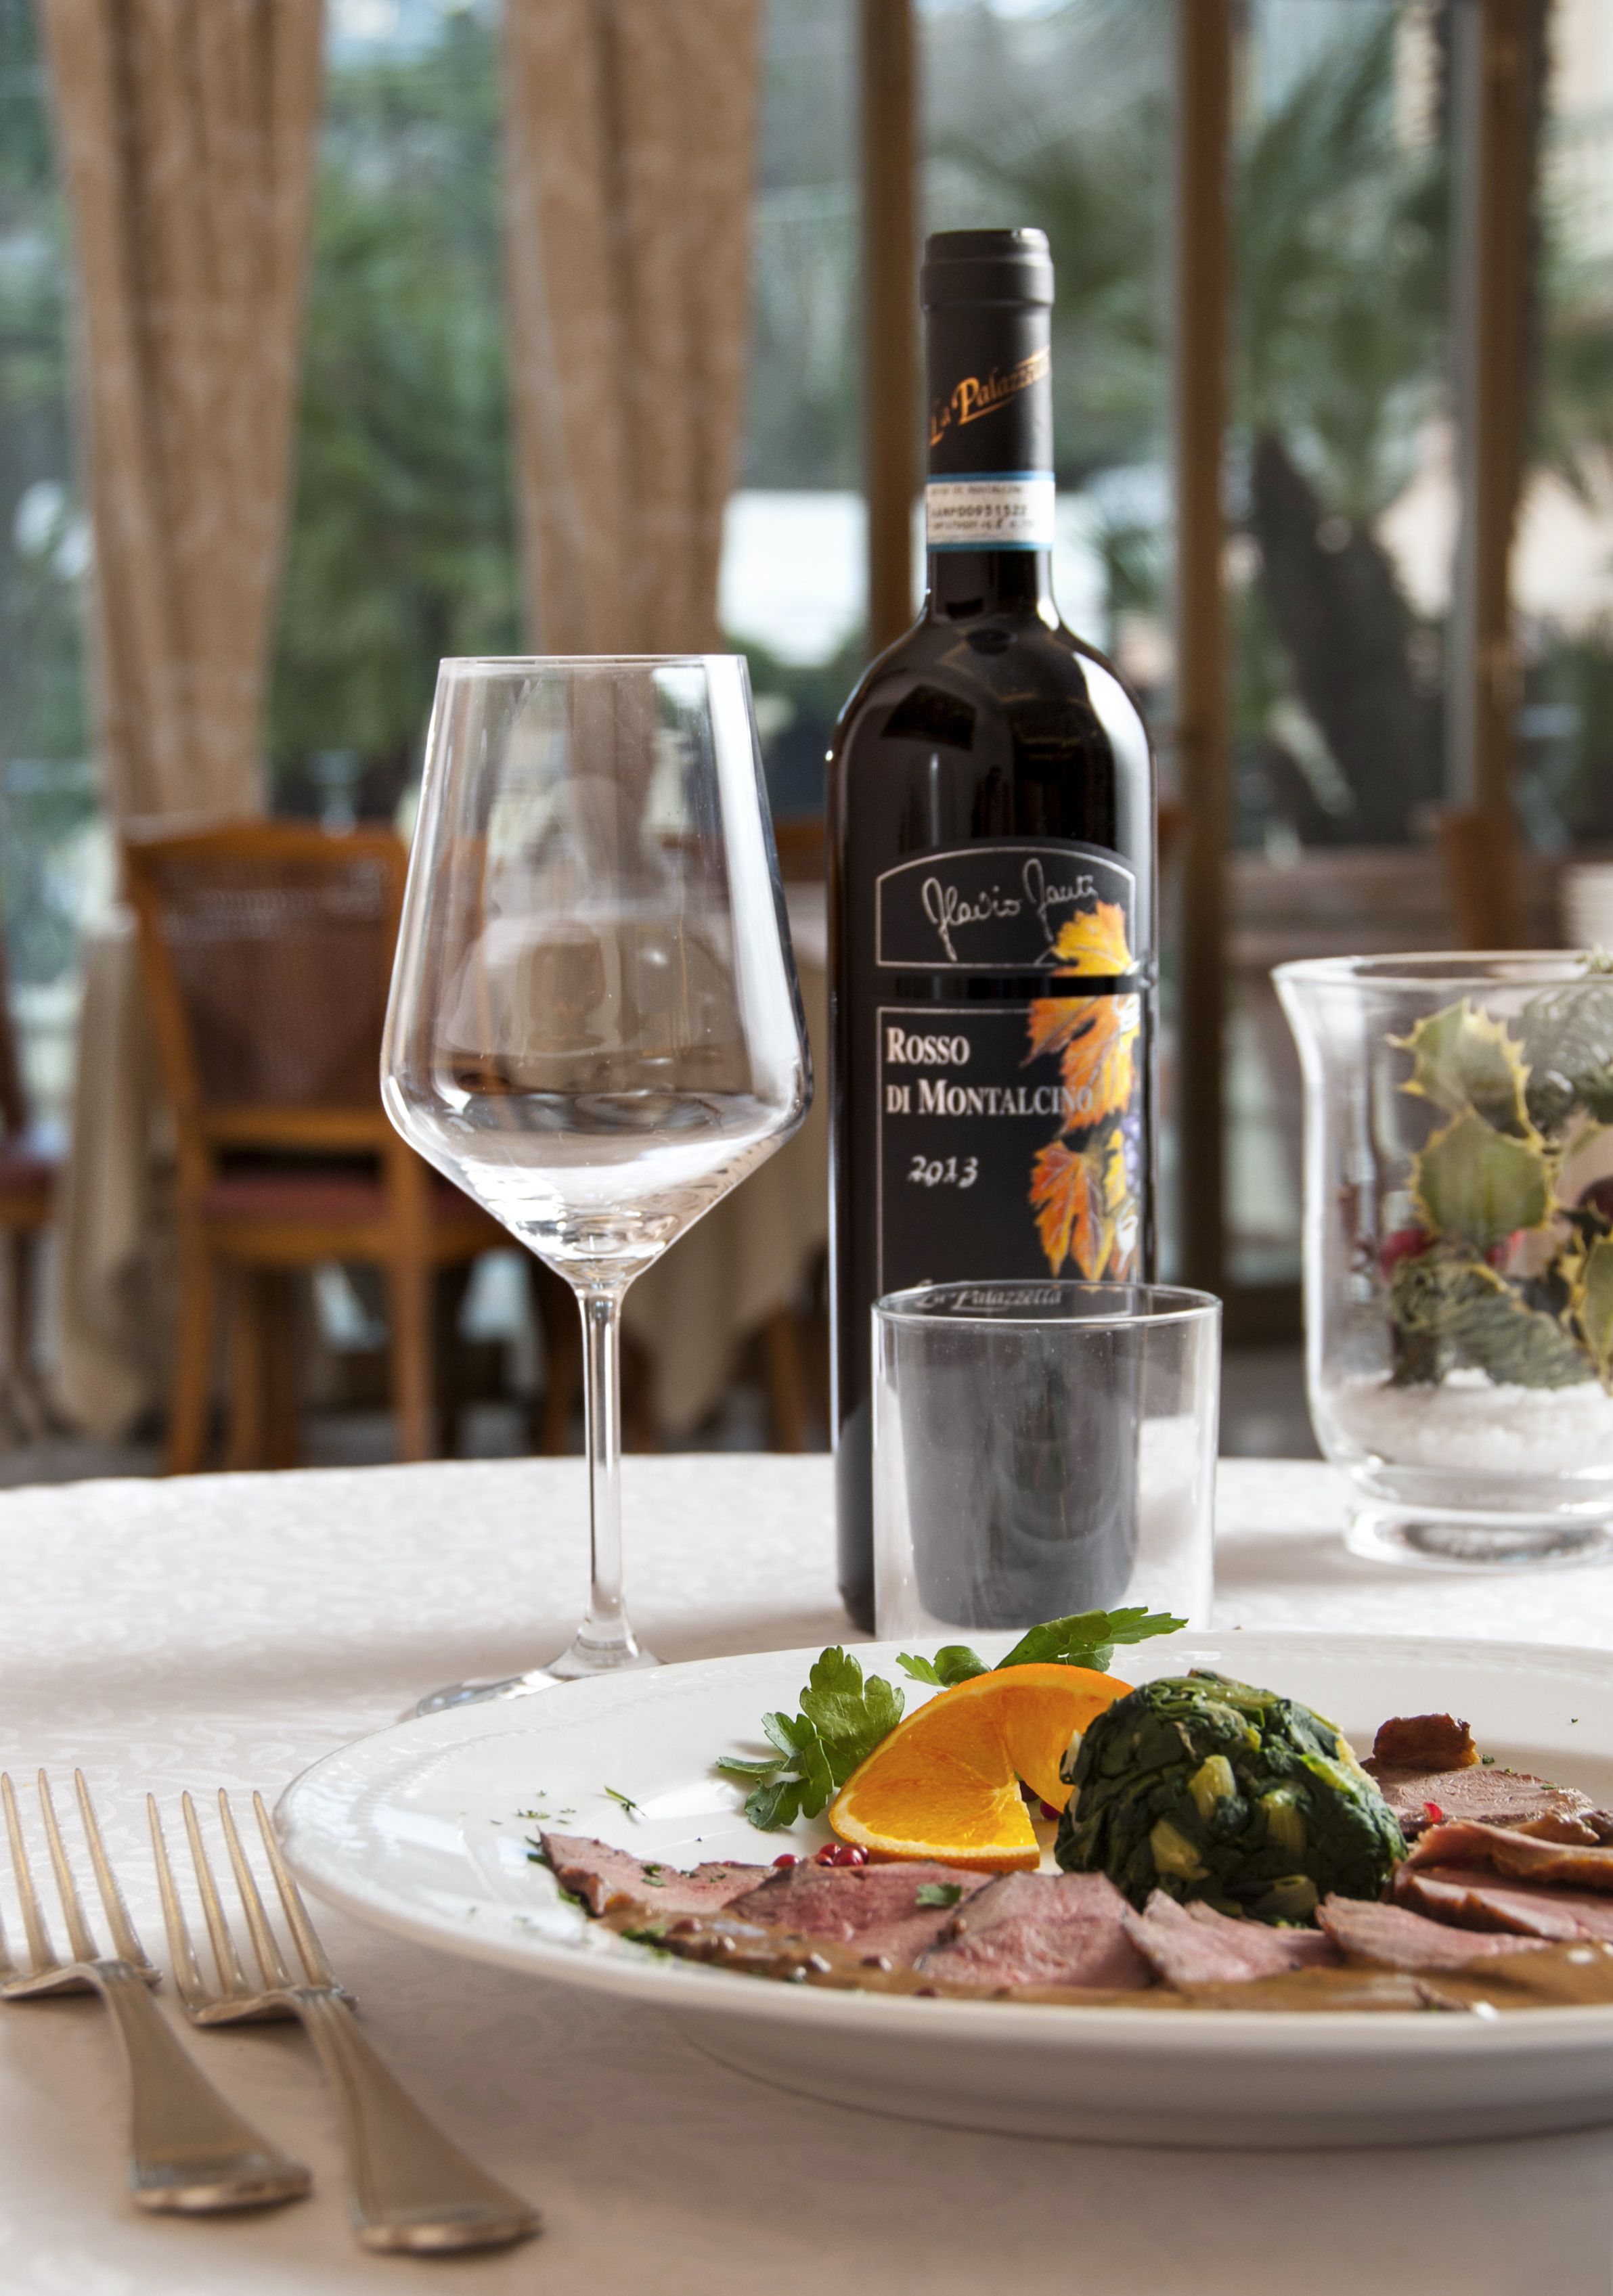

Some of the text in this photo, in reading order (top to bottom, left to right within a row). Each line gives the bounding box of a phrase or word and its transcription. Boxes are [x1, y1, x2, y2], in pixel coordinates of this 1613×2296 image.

[886, 1027, 971, 1066] ROSSO
[887, 1078, 1095, 1116] DI MONTALCINO
[908, 1155, 979, 1188] 2013
